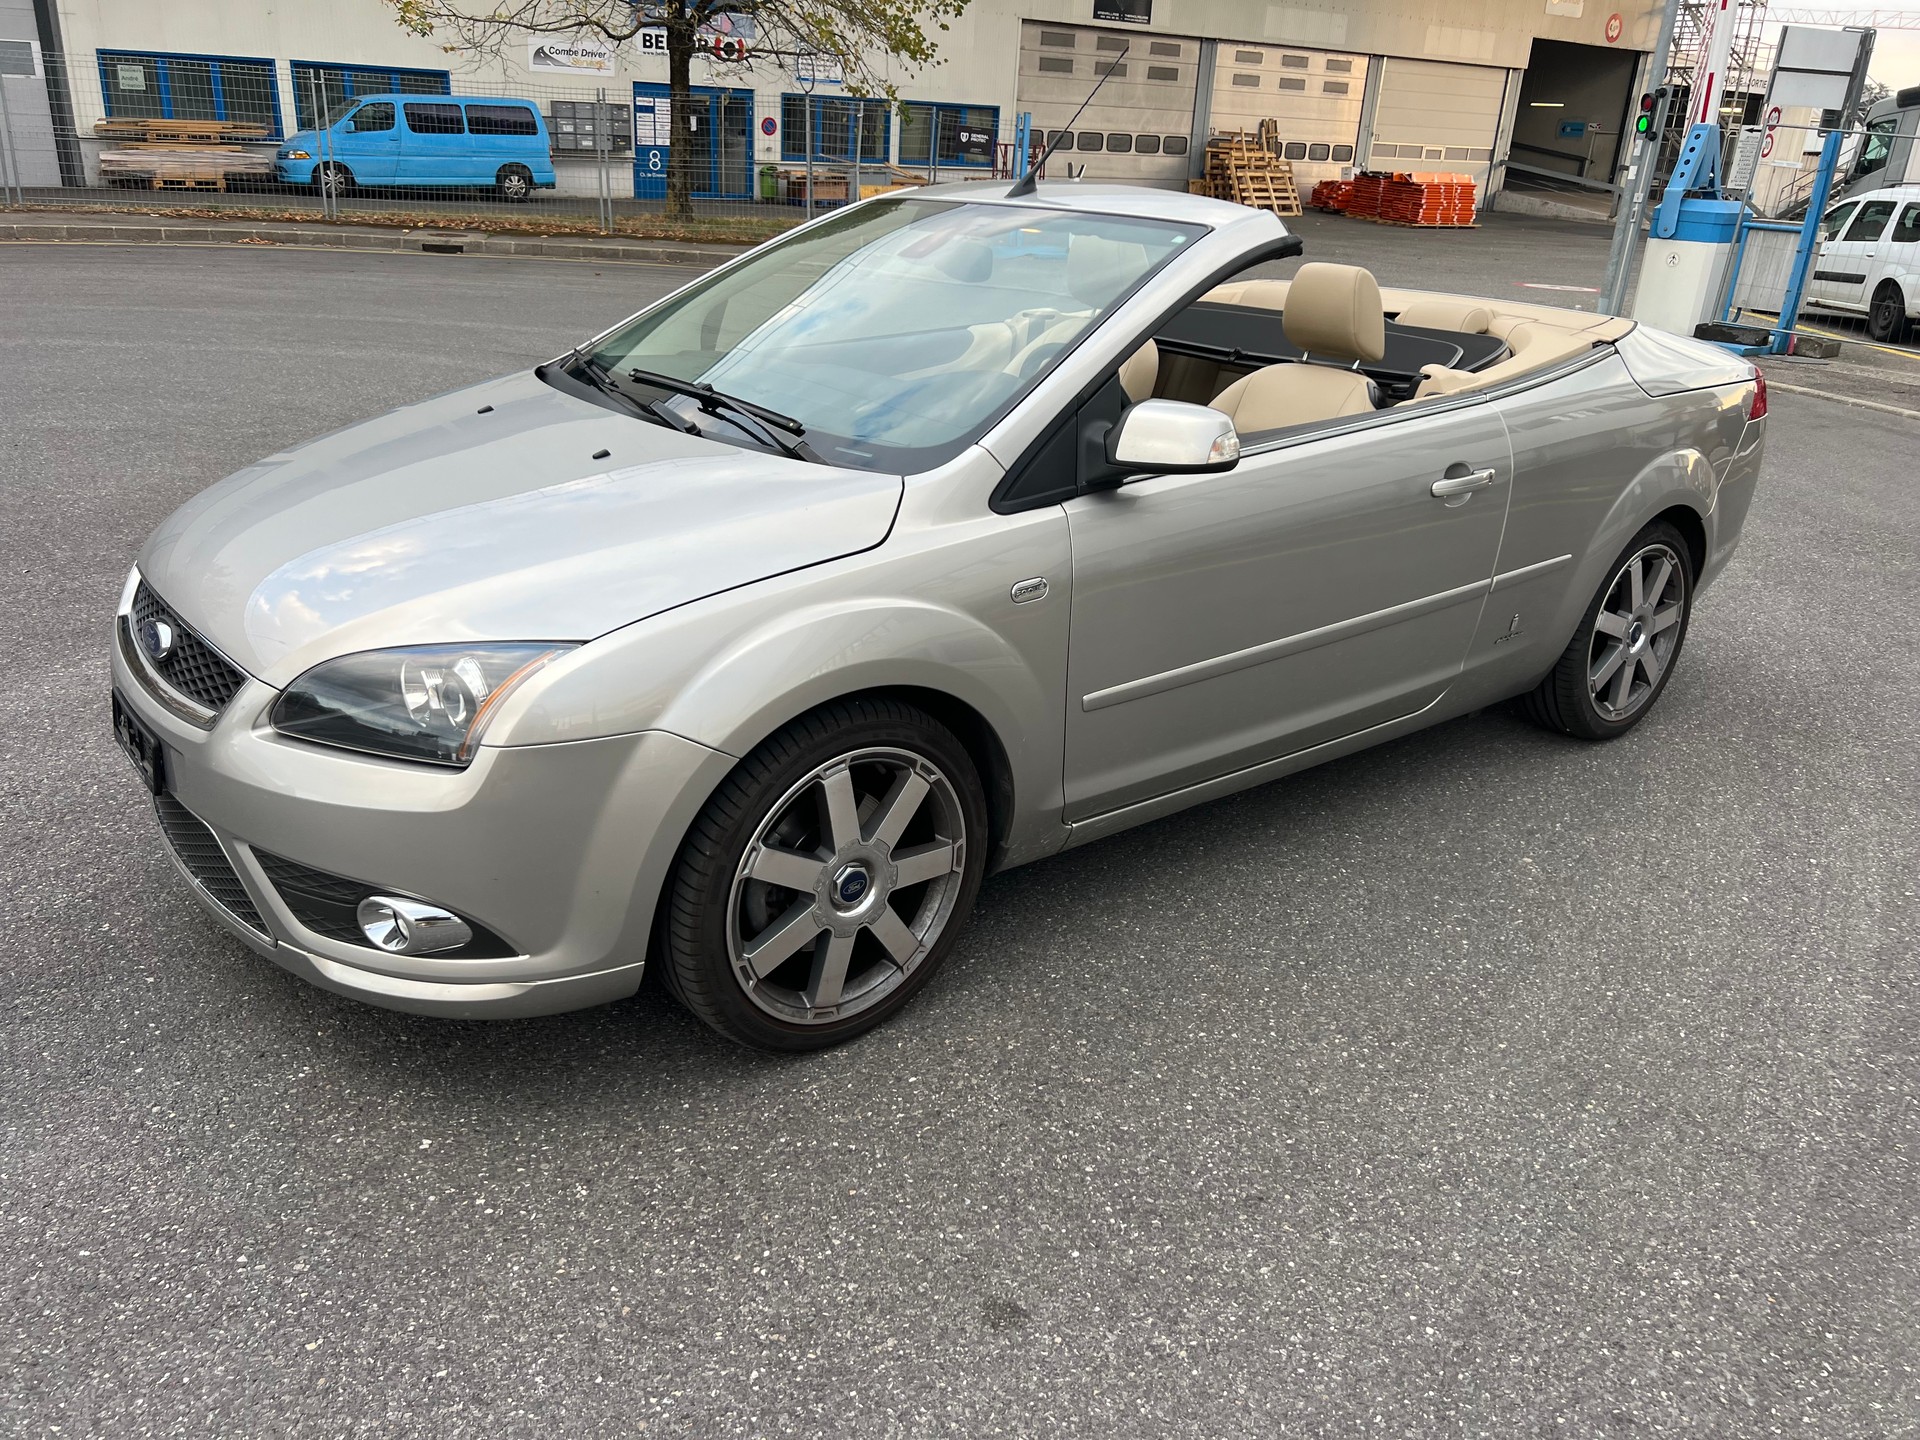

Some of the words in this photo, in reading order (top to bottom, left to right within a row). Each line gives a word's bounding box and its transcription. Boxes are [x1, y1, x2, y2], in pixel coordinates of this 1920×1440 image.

[548, 46, 579, 57] Combe
[581, 48, 607, 59] Driver
[649, 150, 661, 171] 8
